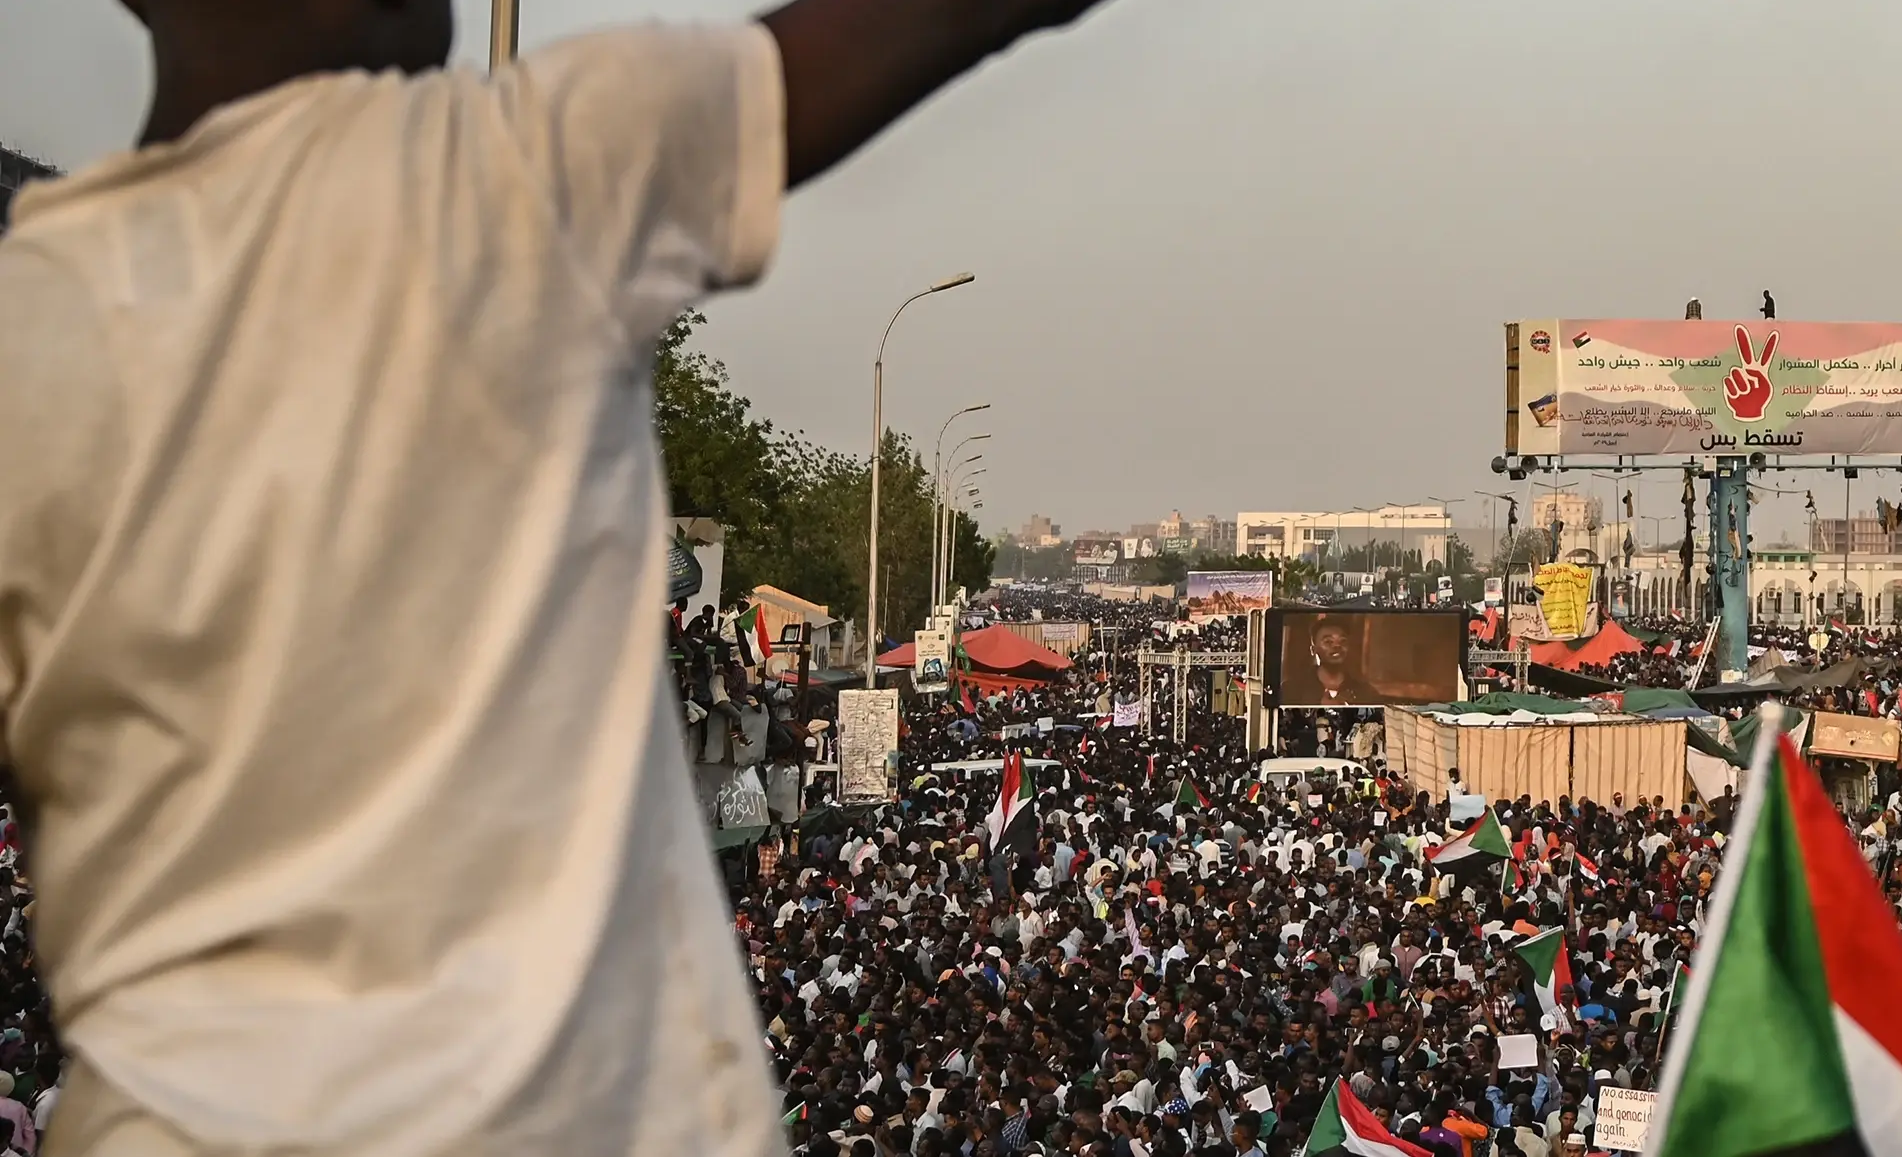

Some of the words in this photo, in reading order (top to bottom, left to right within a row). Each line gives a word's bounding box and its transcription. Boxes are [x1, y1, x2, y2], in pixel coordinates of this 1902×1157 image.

[1578, 355, 1605, 369] واحد
[1609, 354, 1640, 370] جيش
[1658, 356, 1685, 369] واحد
[1689, 355, 1722, 368] شعب
[1779, 357, 1819, 372] المشوار
[1823, 358, 1859, 372] حنكمل
[1875, 357, 1896, 372] أحرار
[1781, 384, 1815, 396] النظام
[1859, 387, 1878, 397] يريد
[1700, 431, 1737, 451] بس
[1743, 429, 1804, 447] تسقط
[1618, 1090, 1658, 1103] assassin
[1597, 1100, 1614, 1119] and
[1616, 1104, 1653, 1125] genocid
